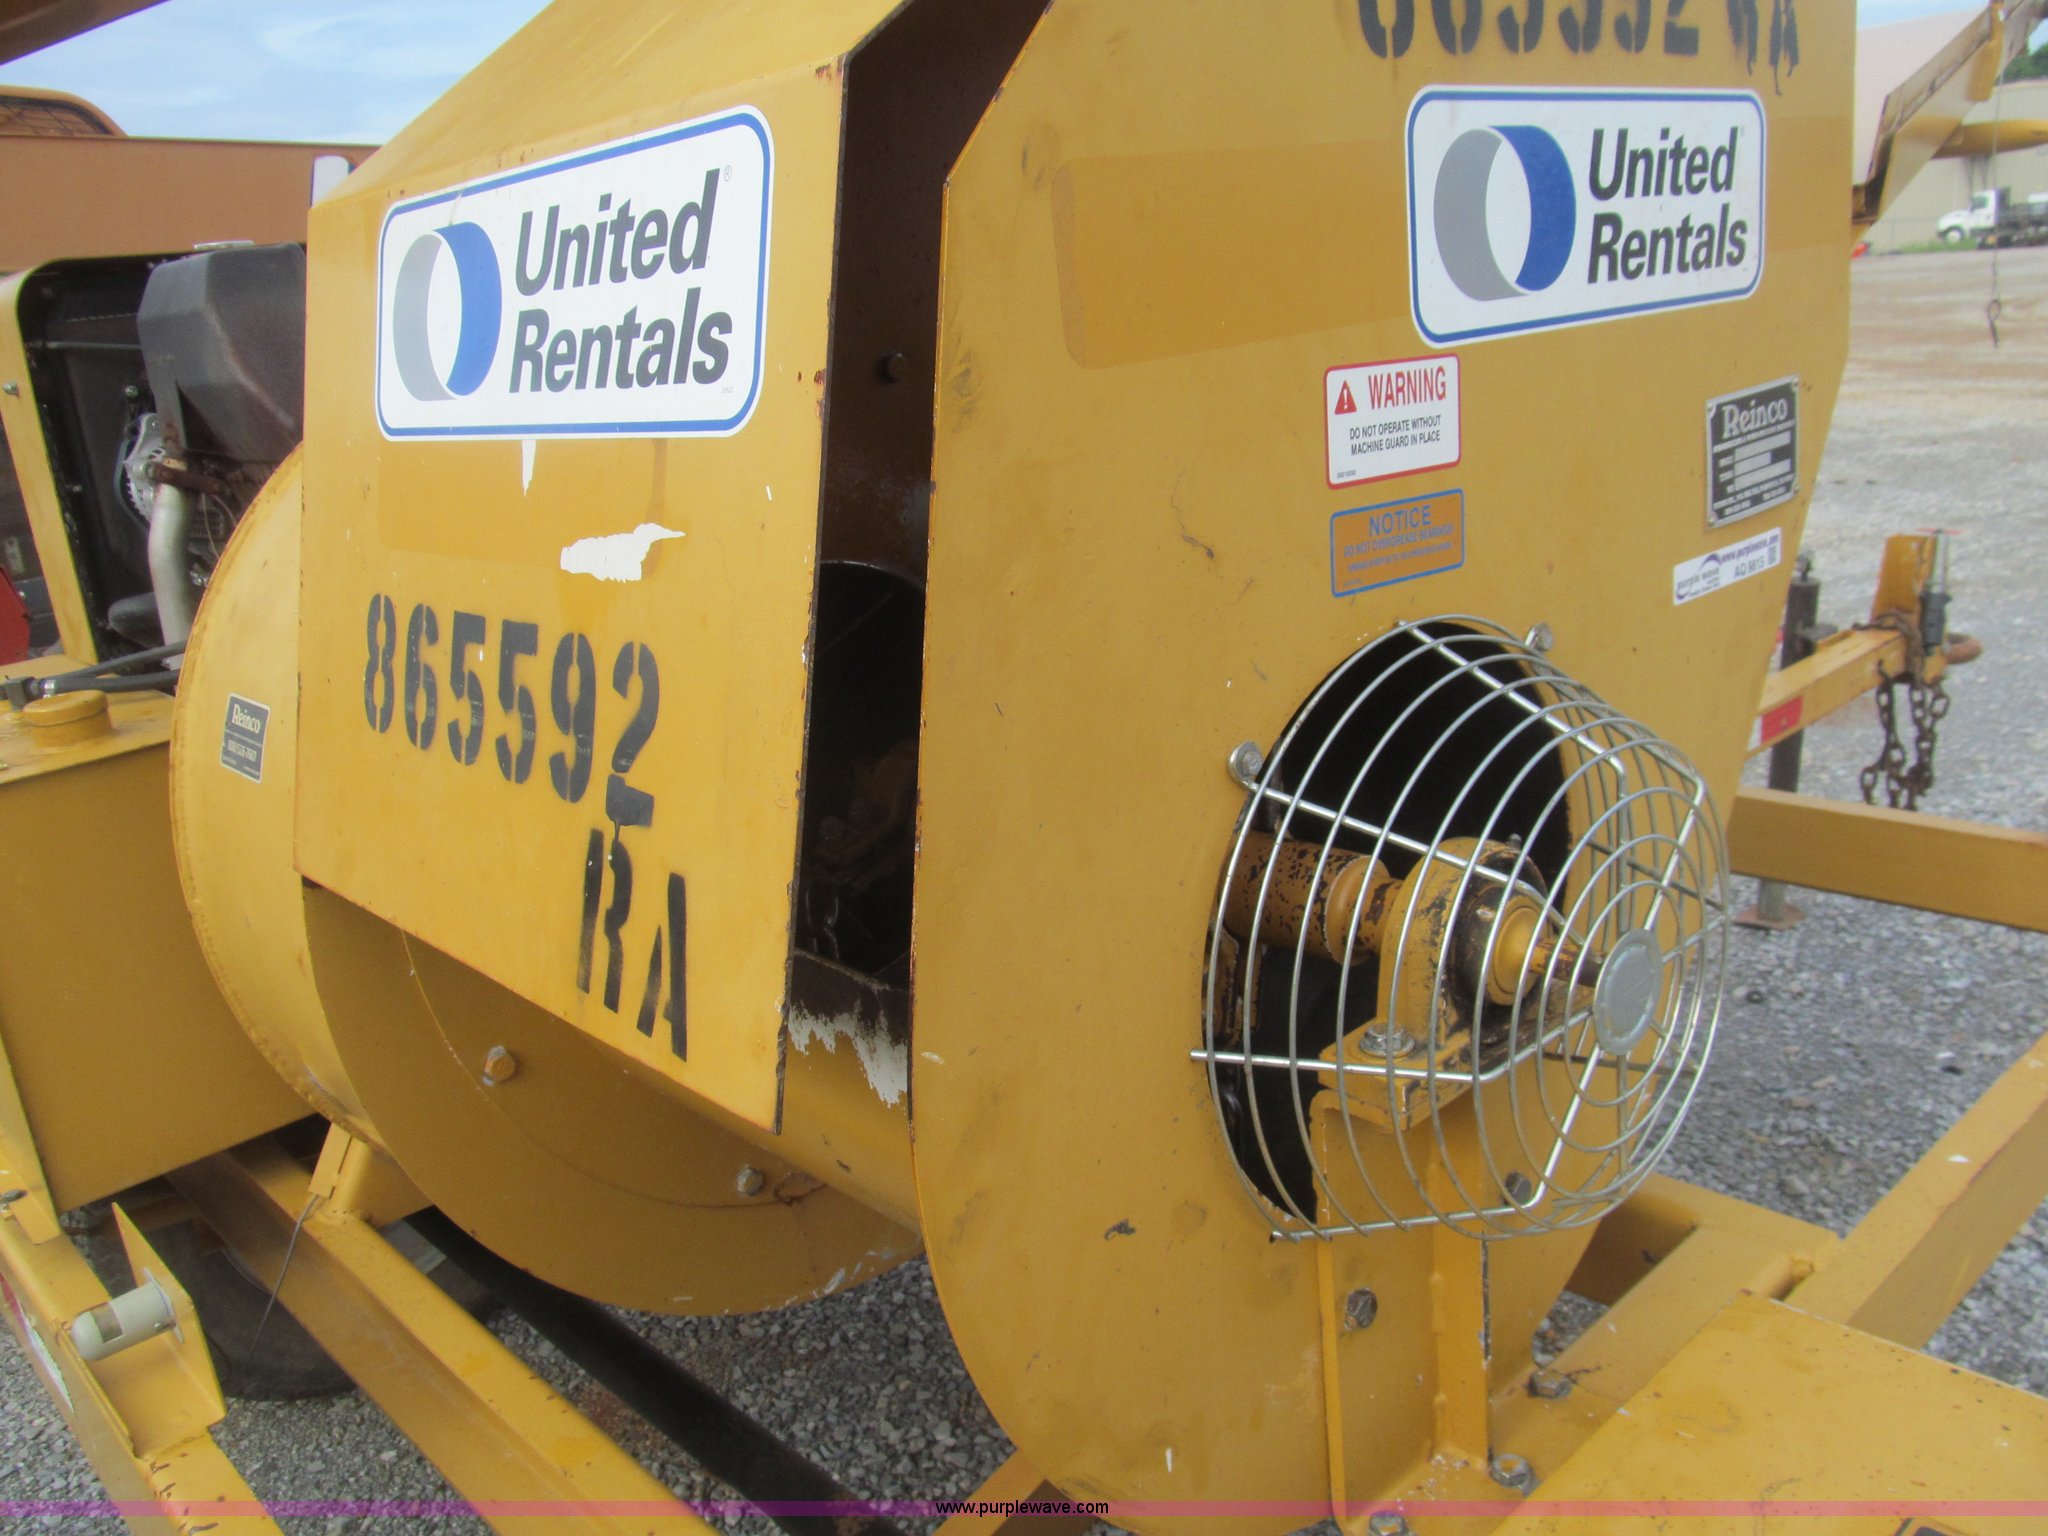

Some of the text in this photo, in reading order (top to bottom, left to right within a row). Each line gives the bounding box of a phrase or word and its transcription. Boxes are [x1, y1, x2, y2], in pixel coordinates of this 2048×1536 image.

[1589, 126, 1739, 200] United
[515, 167, 720, 297] United
[1587, 202, 1747, 284] Rentals
[509, 287, 732, 393] Rentals
[1368, 366, 1446, 410] WARNING
[1350, 414, 1441, 440] DO NOT OPERATE WITHOUT
[1351, 430, 1441, 456] MACHINE GUARD IN PLACE
[1722, 398, 1788, 439] Reinco
[1369, 504, 1432, 536] NOTICE
[231, 703, 261, 734] Reinco
[363, 592, 660, 828] 865592
[575, 827, 688, 1063] RA
